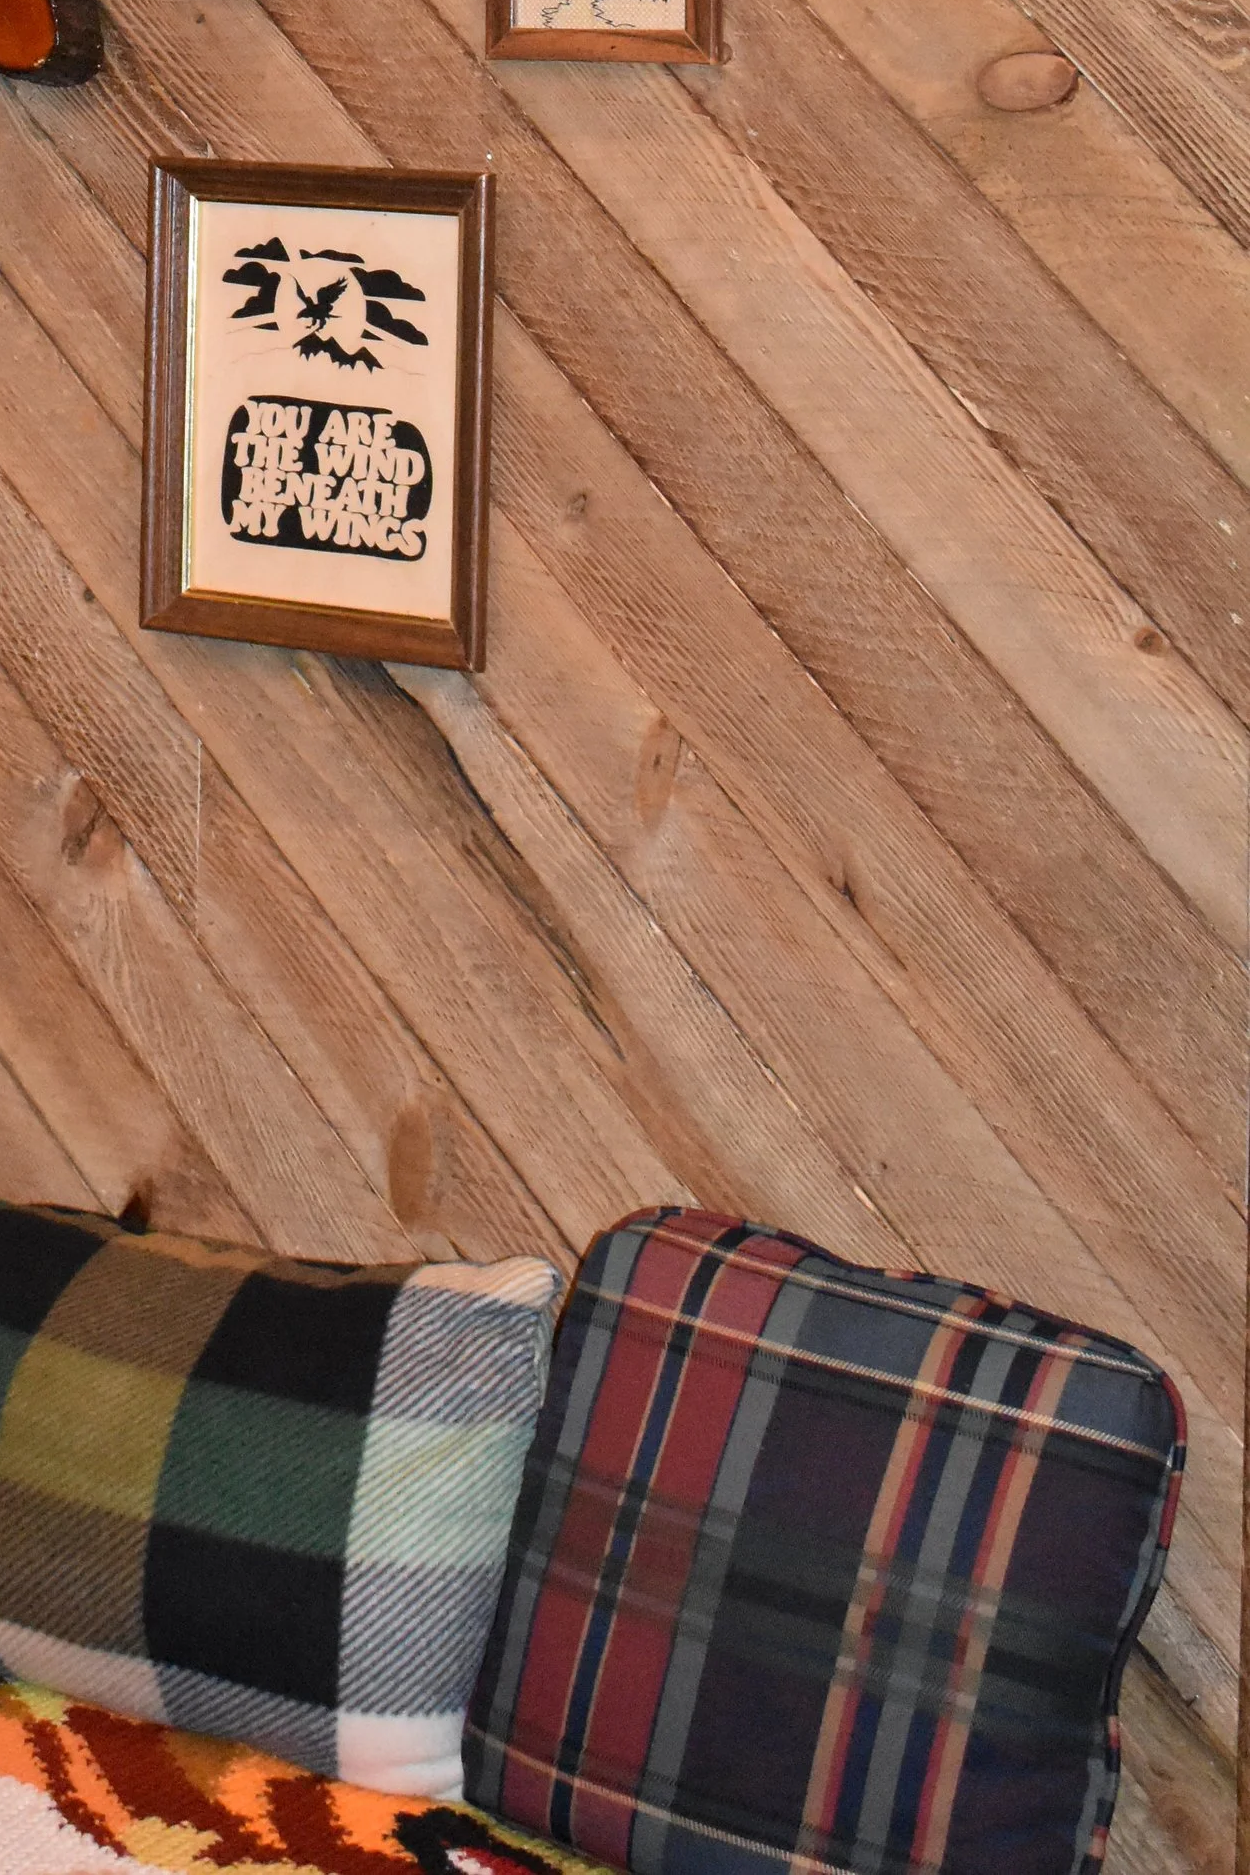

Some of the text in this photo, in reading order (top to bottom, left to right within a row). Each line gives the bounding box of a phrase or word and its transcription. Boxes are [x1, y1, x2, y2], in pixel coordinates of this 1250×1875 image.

[246, 400, 396, 450] YOU ARE
[231, 433, 425, 485] THE WIND
[239, 466, 410, 518] BENEATH
[230, 500, 427, 557] MY WINGS
